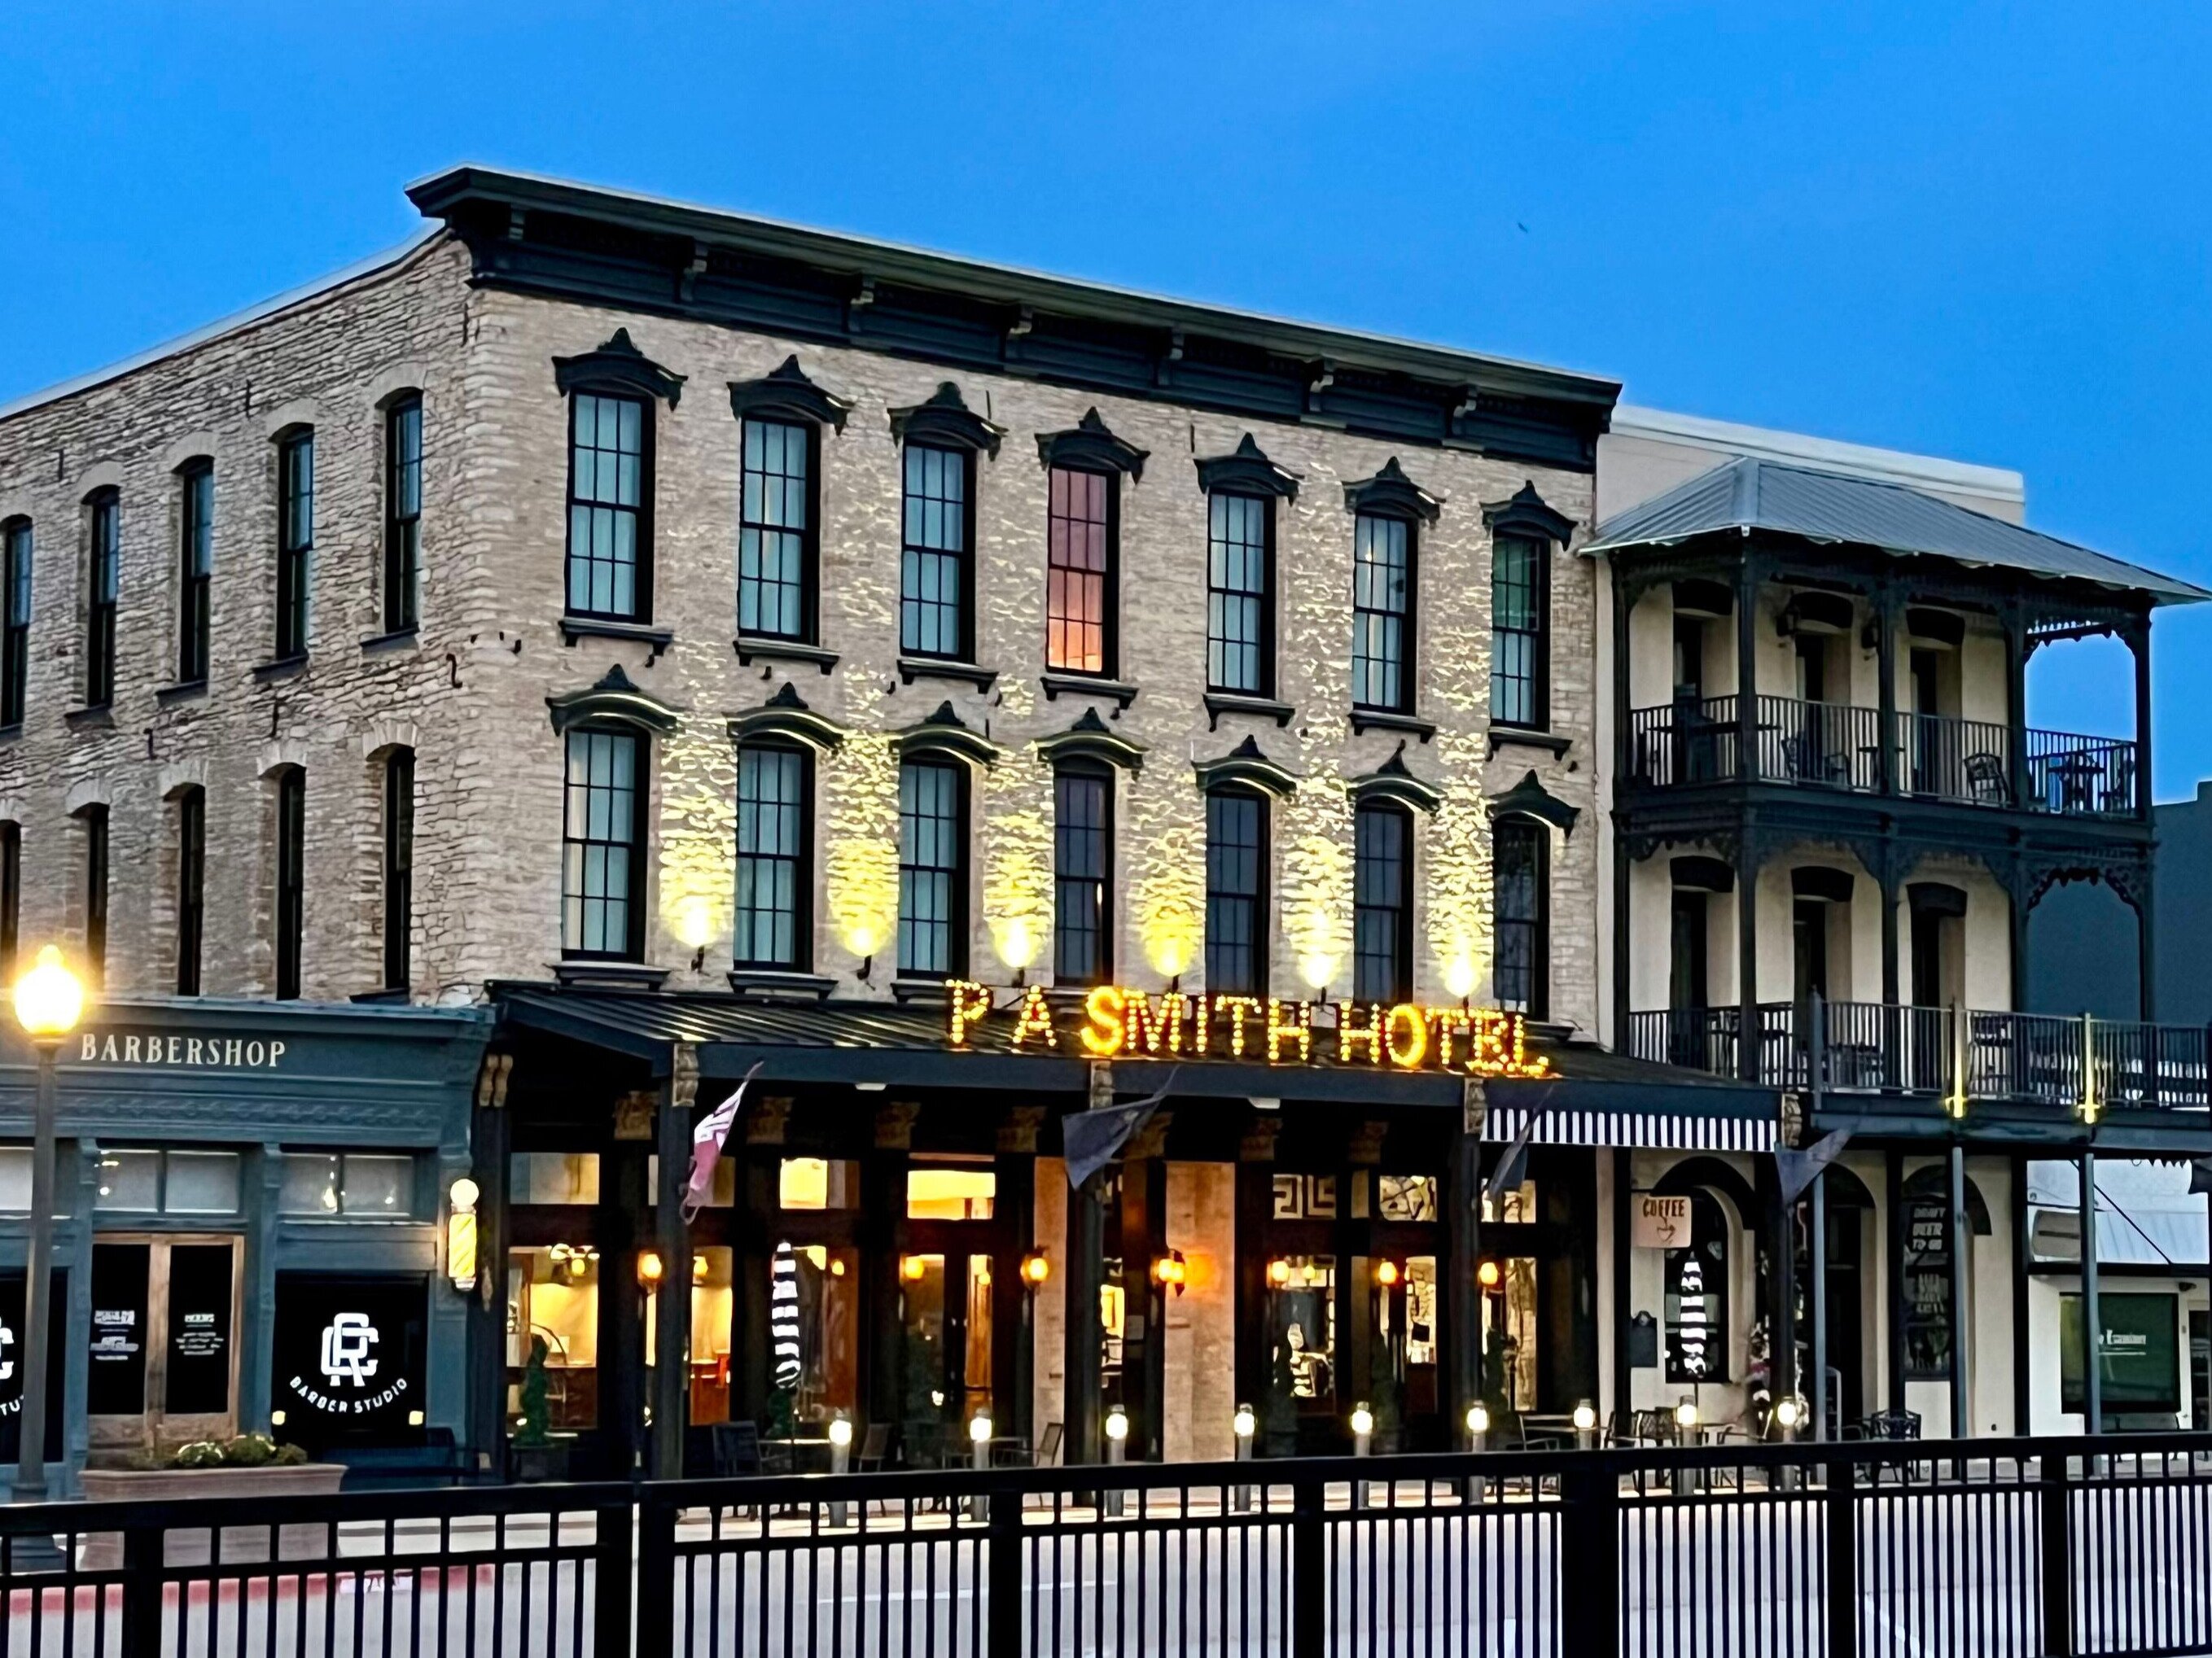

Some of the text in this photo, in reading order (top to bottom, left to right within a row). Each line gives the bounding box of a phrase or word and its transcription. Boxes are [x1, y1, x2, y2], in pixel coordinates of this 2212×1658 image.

[945, 979, 1549, 1077] P A SMITH HOTEL
[81, 1033, 286, 1067] BARBERSHOP
[1643, 1198, 1684, 1218] COFFEE
[290, 1376, 407, 1414] BARBER STUDIO
